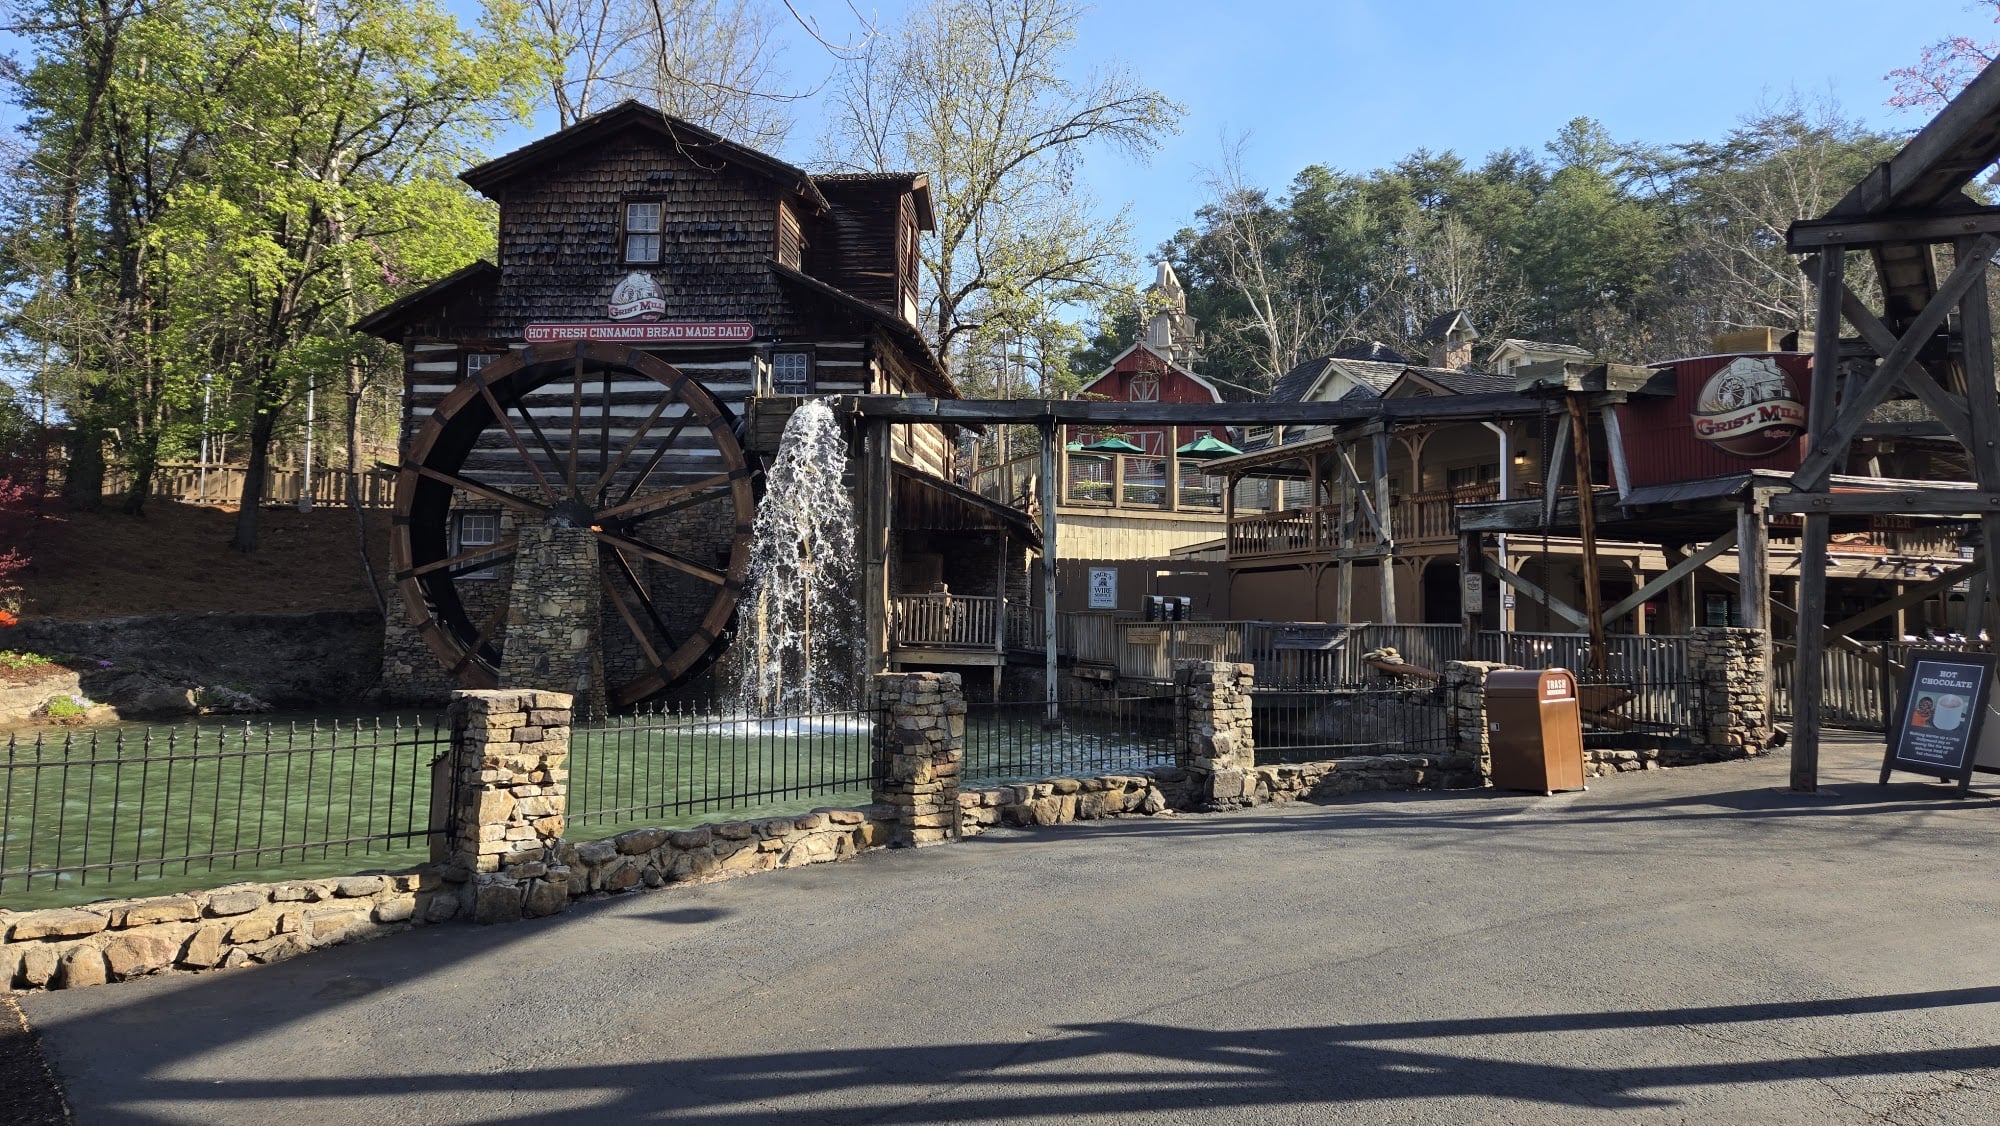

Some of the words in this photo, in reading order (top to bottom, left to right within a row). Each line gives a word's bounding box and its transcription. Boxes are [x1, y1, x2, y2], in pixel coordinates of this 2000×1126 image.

[639, 301, 664, 311] MILL
[528, 328, 550, 339] HOT
[552, 328, 587, 338] FRESH
[590, 327, 644, 338] CINNAMON
[647, 327, 683, 338] BREAD
[685, 326, 716, 337] MADE
[718, 326, 750, 337] DAILY
[1697, 413, 1755, 435] GRIST
[1757, 405, 1803, 423] MILL
[1873, 514, 1911, 528] ENTER
[1939, 670, 1958, 678] HOT
[1546, 679, 1566, 689] TRASH
[1921, 677, 1972, 688] CHOCOLATE
